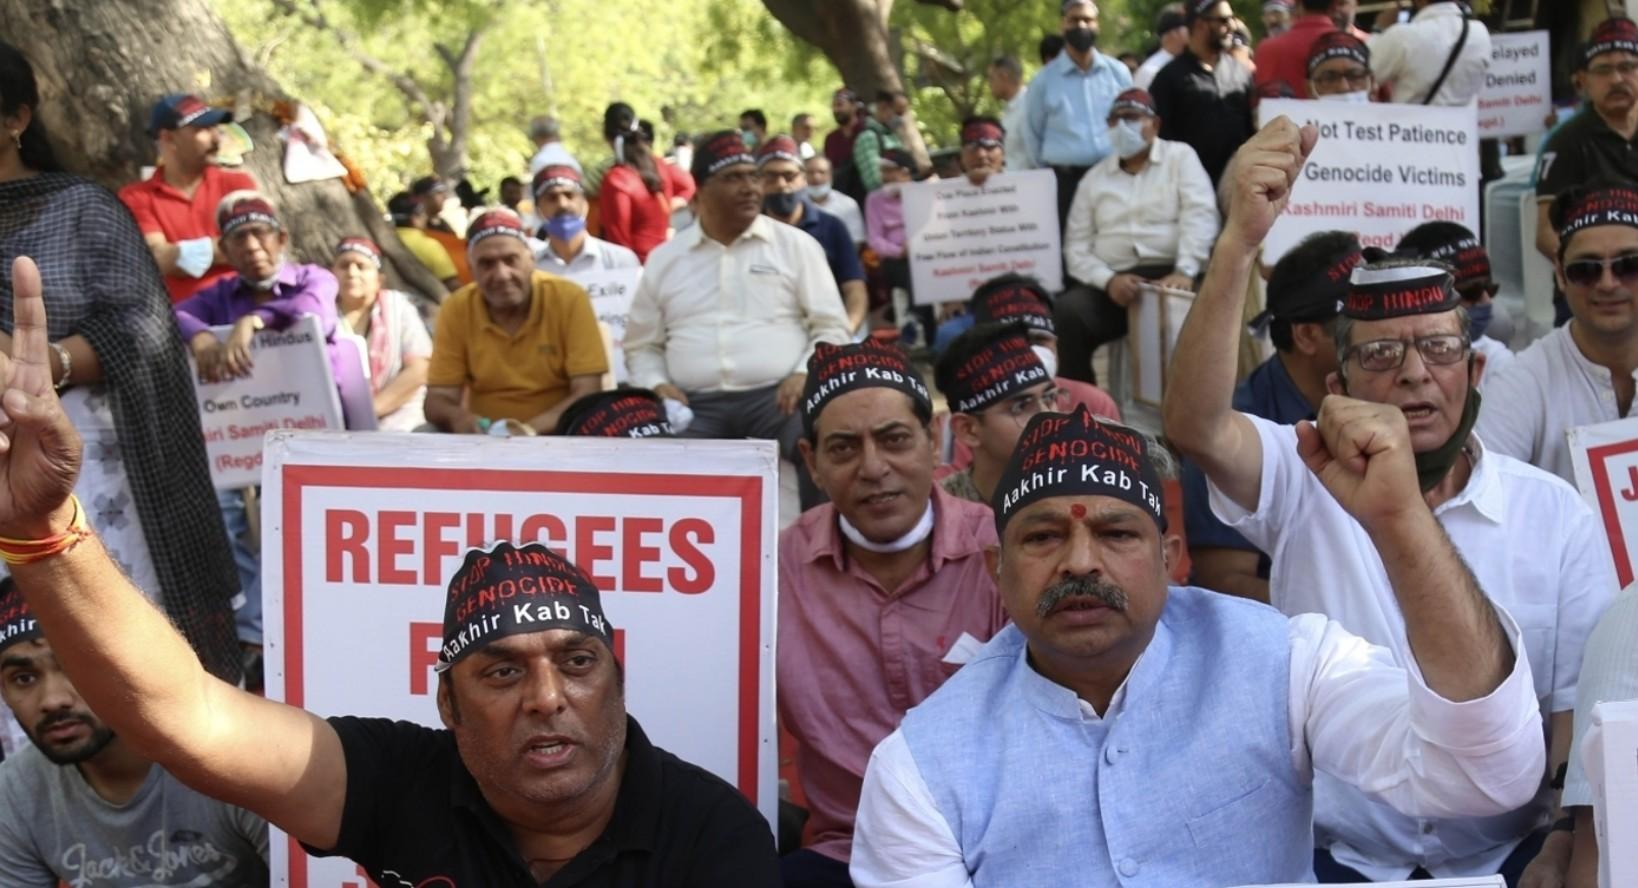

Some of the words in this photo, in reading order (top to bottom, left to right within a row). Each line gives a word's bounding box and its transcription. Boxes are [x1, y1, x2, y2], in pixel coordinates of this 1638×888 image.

[1491, 45, 1539, 61] elayed
[1486, 73, 1536, 88] Denied
[1343, 120, 1382, 142] Test
[1389, 123, 1467, 145] Patience
[1304, 162, 1393, 183] Genocide
[1398, 165, 1466, 187] Victims
[1363, 201, 1416, 220] Samiti
[1422, 204, 1465, 221] Delhi
[1383, 285, 1445, 312] HINDU
[259, 331, 313, 348] Hindus
[806, 371, 857, 414] Aakhir
[865, 367, 904, 383] Kab
[959, 380, 1010, 411] Aakhir
[1015, 366, 1046, 384] Kab
[203, 398, 238, 413] Own
[241, 390, 301, 409] Country
[228, 418, 279, 440] Samiti
[284, 414, 327, 429] Delhi
[628, 423, 660, 439] Kab
[1022, 439, 1140, 473] GENOCIDE
[1003, 466, 1068, 515] Aakhir
[1081, 463, 1132, 490] Kab
[1139, 480, 1162, 517] Tak
[456, 576, 579, 623] GENOCIDE
[0, 618, 37, 643] khir
[443, 612, 501, 663] Aakhir
[513, 600, 571, 625] Kab
